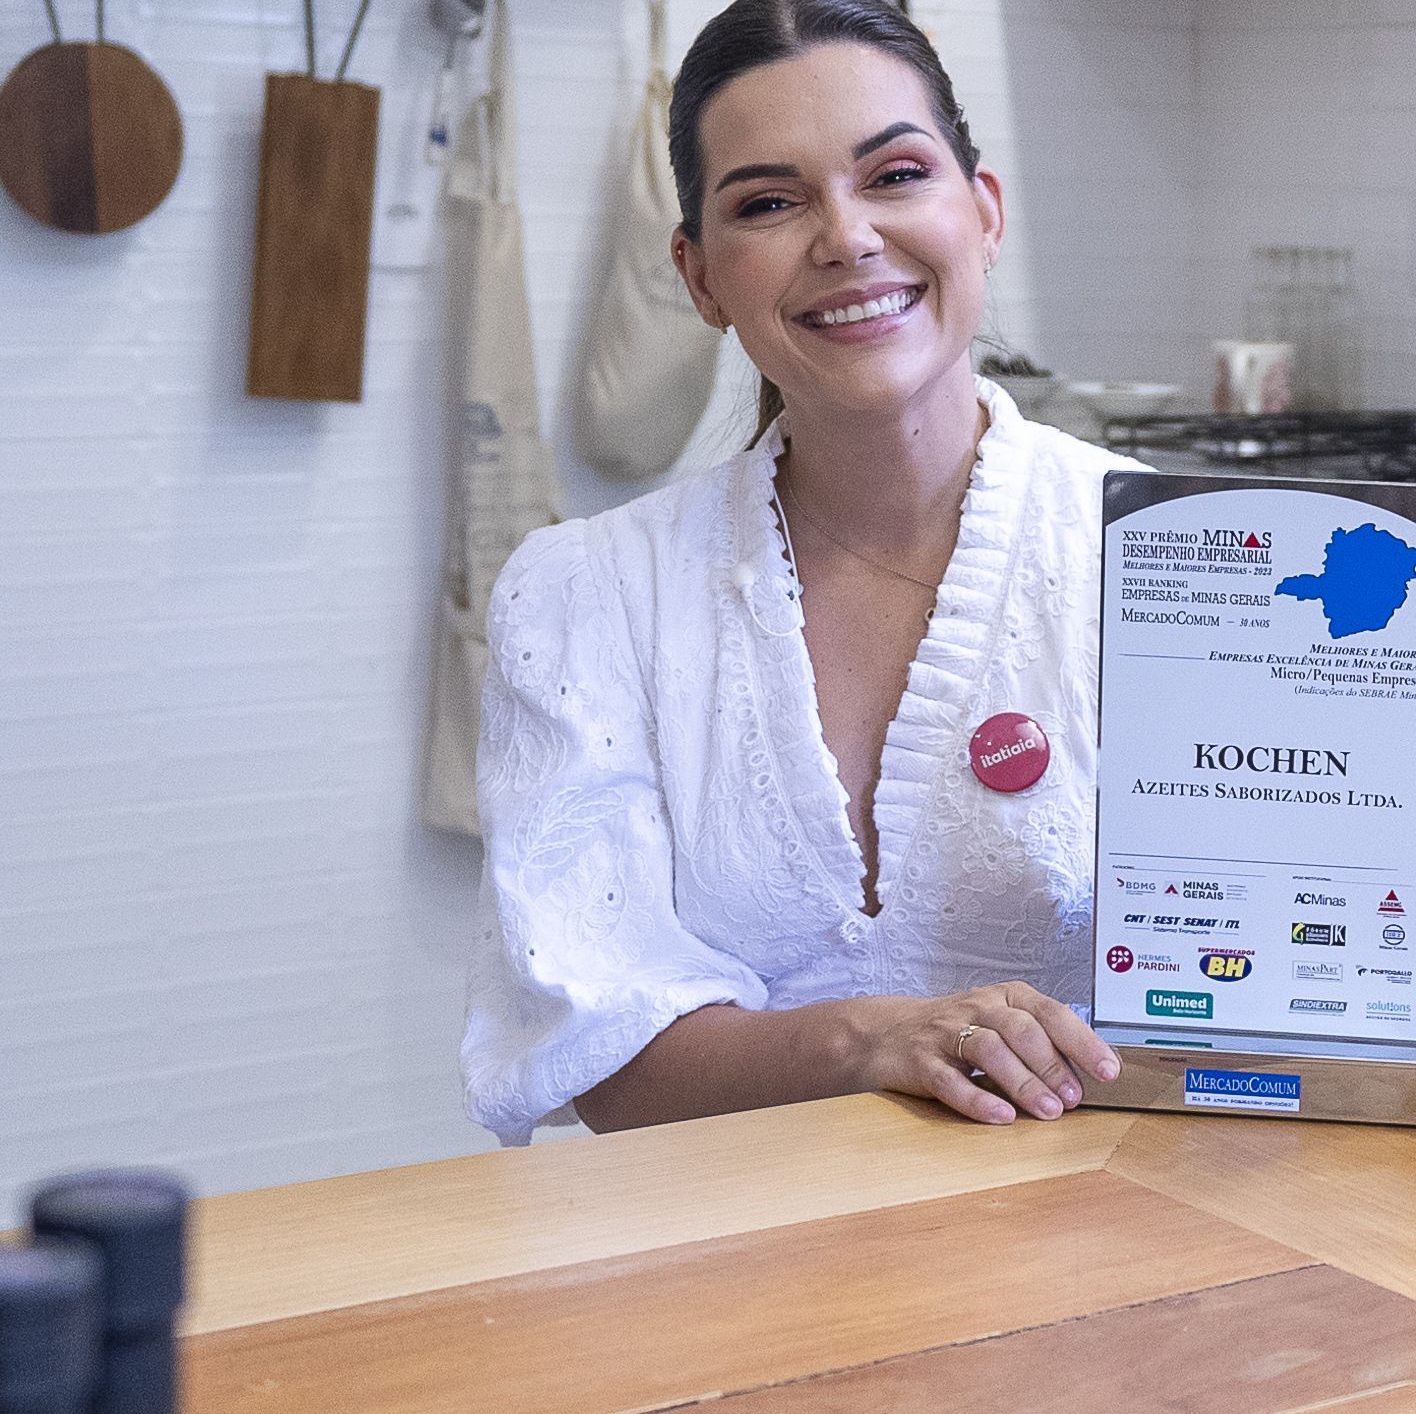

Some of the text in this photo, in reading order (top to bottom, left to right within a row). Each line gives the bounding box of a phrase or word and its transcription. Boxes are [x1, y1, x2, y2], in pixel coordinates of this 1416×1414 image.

[1122, 530, 1147, 542] XXV
[1150, 529, 1198, 544] PRÊMIO
[1122, 543, 1272, 565] DESEMPENHO EMPRESARIAL
[1148, 578, 1188, 589] RANKING
[1121, 588, 1180, 602] EMPRESAS
[1191, 591, 1227, 605] MINAS
[1229, 593, 1271, 607] GERAIS
[1309, 643, 1369, 657] MELHORES
[1370, 648, 1379, 657] E
[1208, 650, 1264, 663] EMPRESAS
[1266, 653, 1332, 667] EXCELÊNCIA
[1334, 659, 1350, 667] DE
[1351, 658, 1388, 670] MINAS
[1270, 666, 1369, 686] Micro/Pequenas
[1345, 688, 1358, 697] do
[1359, 688, 1398, 700] SEBRAE
[979, 738, 1037, 769] itatiaia
[1193, 742, 1352, 778] KOCHEN
[1131, 778, 1404, 809] AZEITES SABORIZADOS LTDA.
[1126, 881, 1157, 891] BDMG
[1183, 880, 1219, 891] MINAS
[1183, 889, 1224, 901] GERAIS
[1294, 892, 1347, 907] ACMinas
[1124, 913, 1146, 924] CNT
[1152, 915, 1181, 926] SEST
[1183, 917, 1219, 928] SENAT
[1329, 924, 1345, 946] JK
[1137, 954, 1172, 963] HERMES
[1137, 961, 1180, 972] PARDINI
[1207, 956, 1246, 978] BH
[1152, 994, 1207, 1009] Unimed
